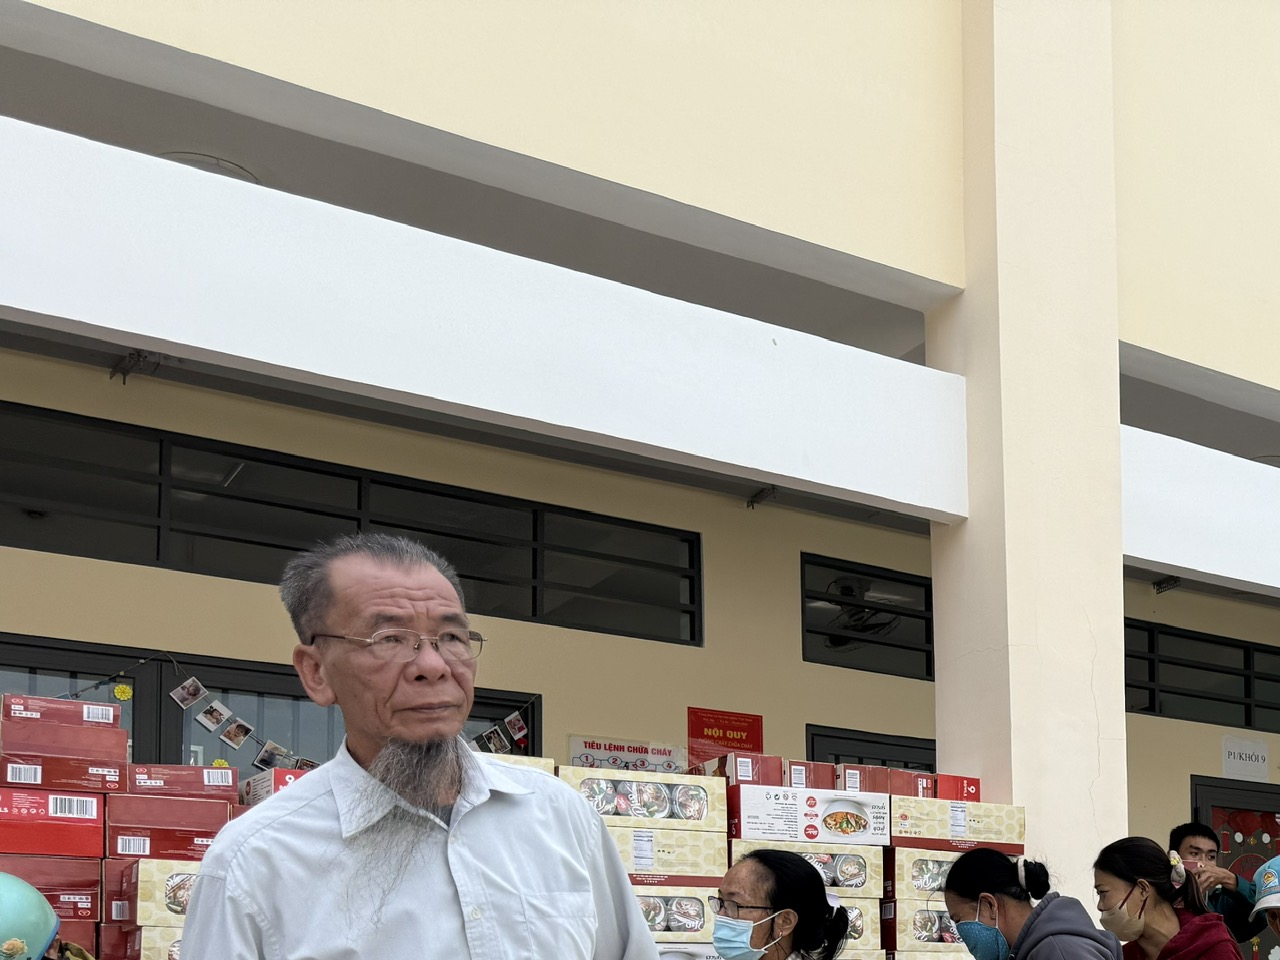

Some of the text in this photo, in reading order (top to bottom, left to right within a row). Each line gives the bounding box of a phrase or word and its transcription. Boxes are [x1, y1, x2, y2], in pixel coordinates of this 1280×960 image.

[727, 731, 747, 740] QUY
[583, 740, 672, 757] TIÊU LỆNH CHỮA CHÁY
[612, 757, 618, 765] 2
